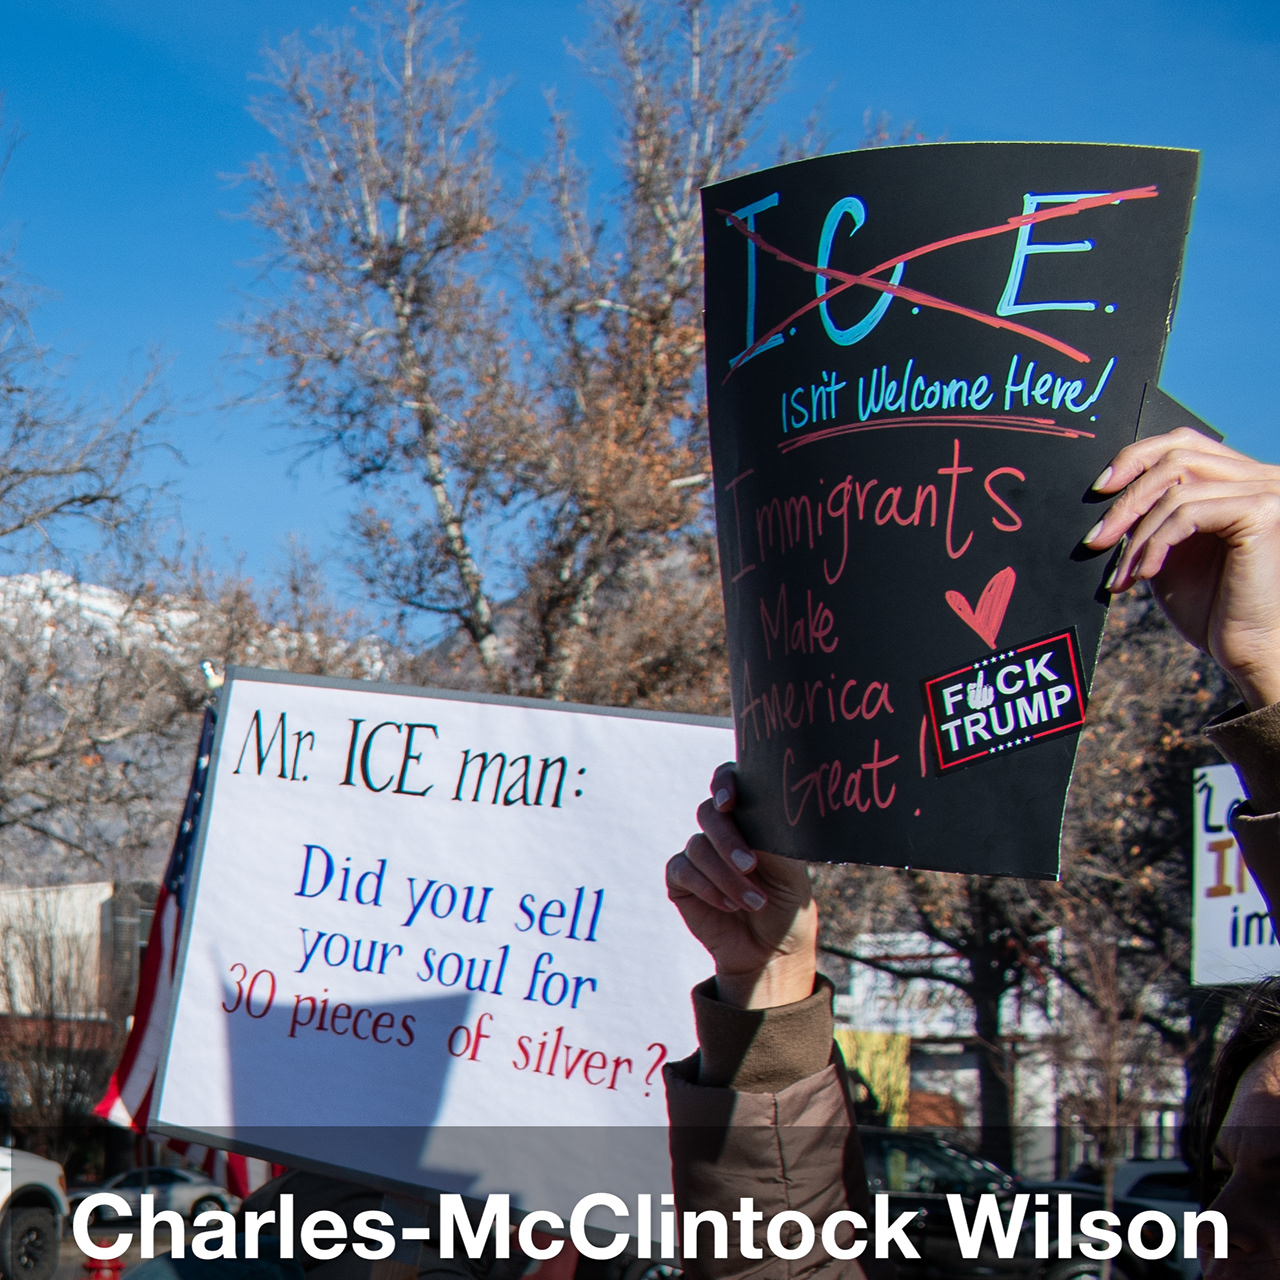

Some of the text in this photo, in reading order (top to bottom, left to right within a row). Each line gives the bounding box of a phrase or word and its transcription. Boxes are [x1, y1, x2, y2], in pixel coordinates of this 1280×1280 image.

[858, 358, 995, 421] Welcome
[1004, 354, 1117, 421] Here!
[725, 438, 1027, 586] Immigrants
[760, 581, 840, 660] Make
[740, 659, 895, 750] America
[940, 682, 1075, 752] TRUMP
[232, 709, 587, 808] Mr. ICE man:
[294, 844, 605, 943] Did you sell
[221, 963, 277, 1019] 30
[287, 989, 418, 1047] pieces
[447, 1012, 493, 1062] of
[294, 928, 598, 1009] your soul for
